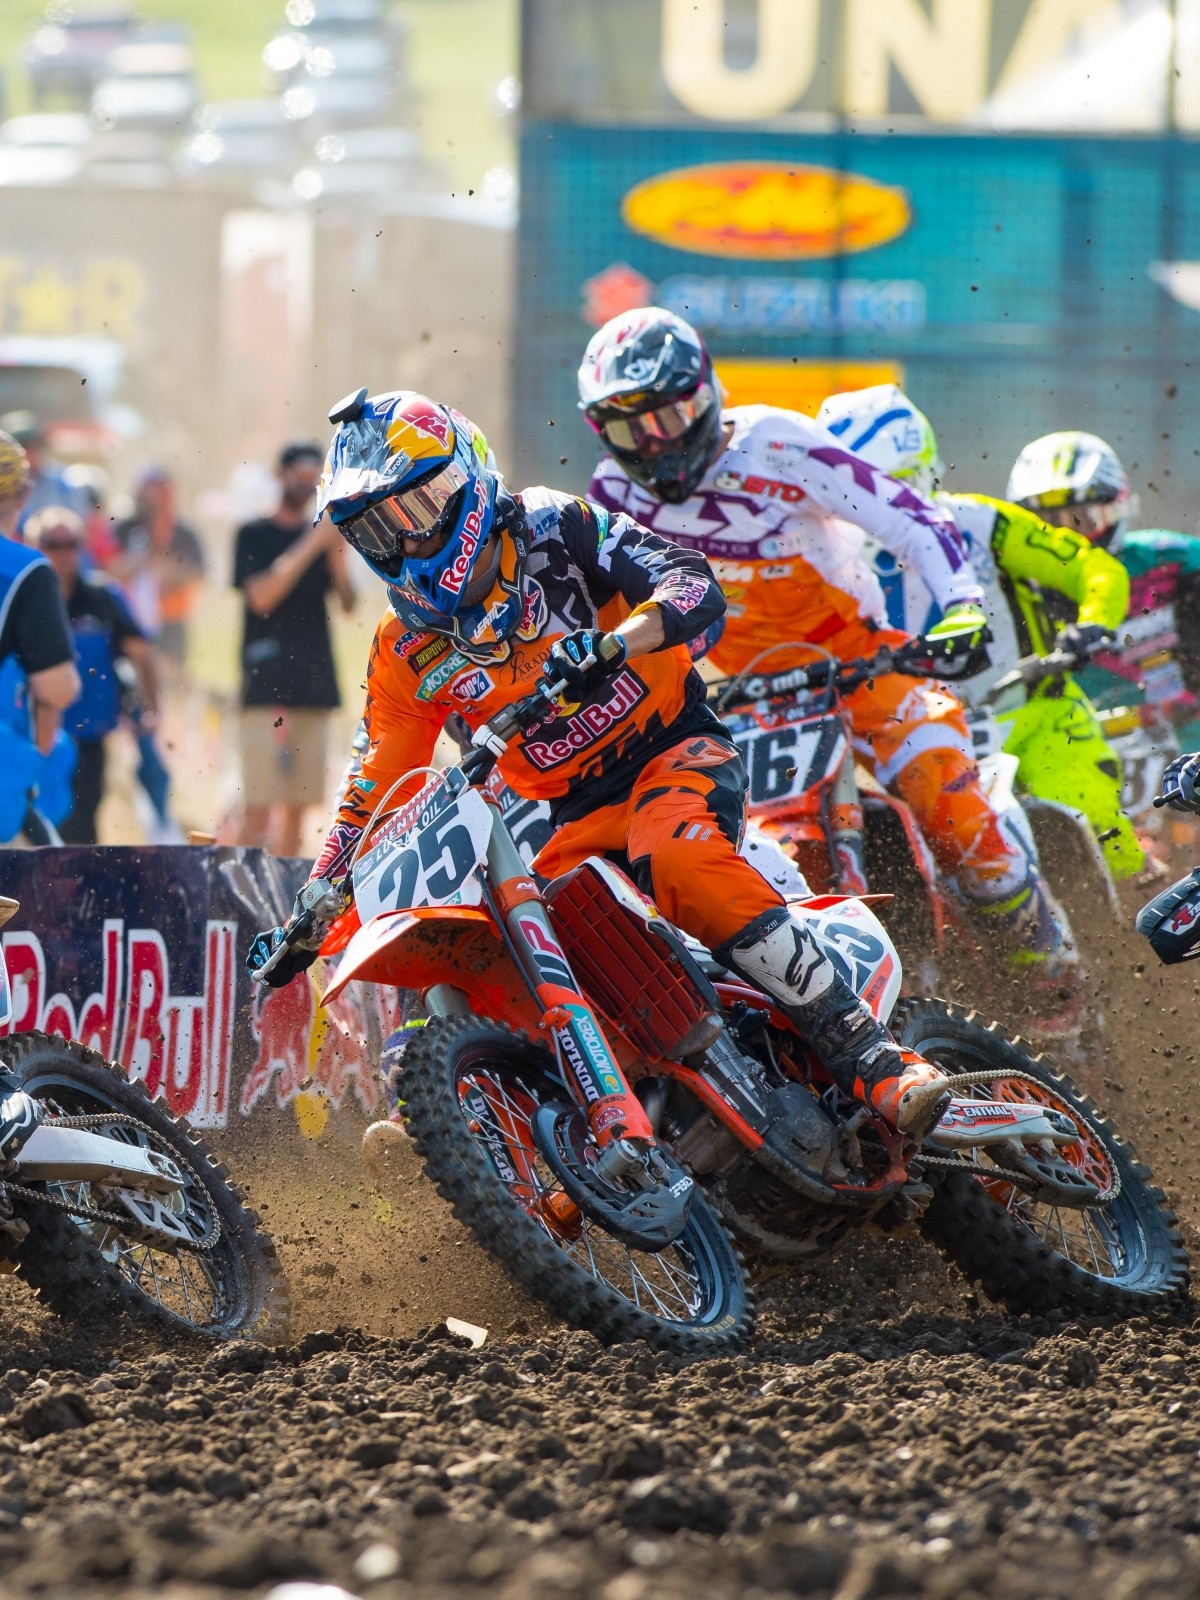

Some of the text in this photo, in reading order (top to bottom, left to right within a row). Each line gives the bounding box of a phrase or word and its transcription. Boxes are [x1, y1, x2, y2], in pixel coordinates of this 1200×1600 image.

[440, 478, 488, 596] Red Bull
[425, 651, 467, 692] MOTORE
[525, 671, 643, 767] Red Bull
[379, 802, 477, 911] 25
[421, 801, 443, 827] OIL
[117, 922, 238, 1124] Bull
[574, 1015, 614, 1075] MOTOREX
